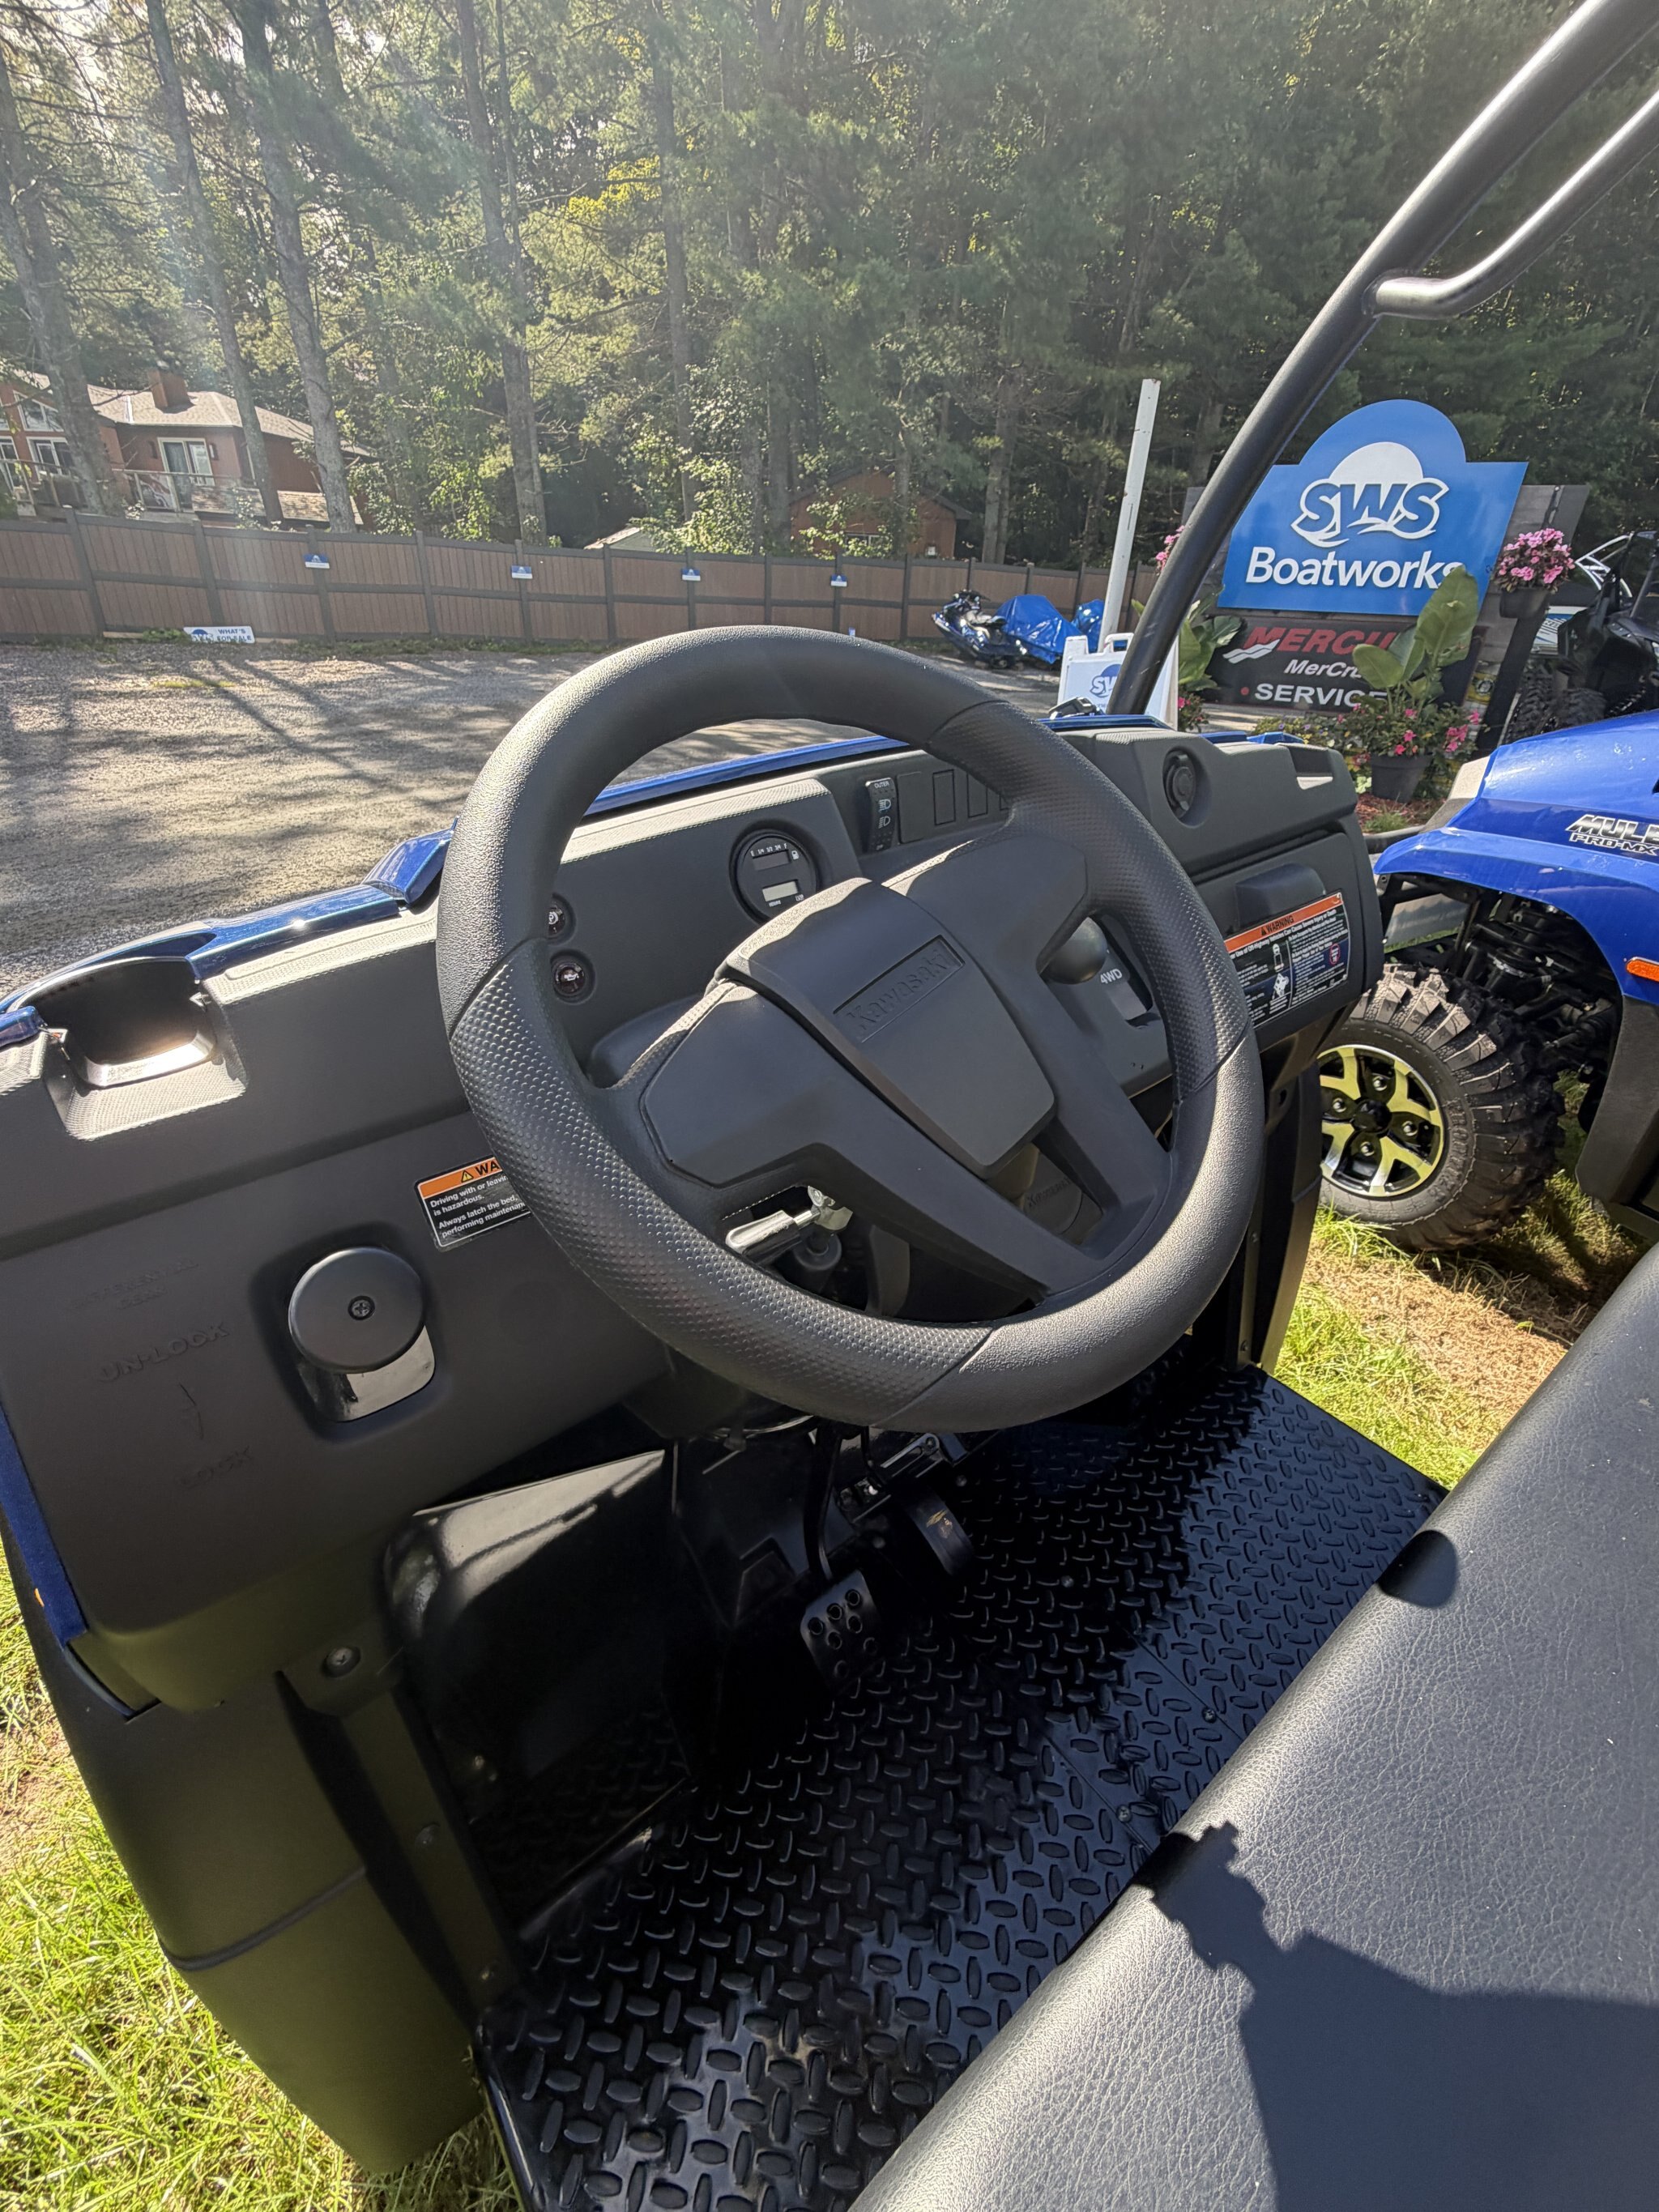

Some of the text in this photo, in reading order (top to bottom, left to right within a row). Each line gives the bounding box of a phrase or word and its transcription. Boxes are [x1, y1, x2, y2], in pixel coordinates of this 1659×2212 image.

[1290, 478, 1449, 547] SWS
[1243, 627, 1397, 655] MERCU
[1267, 915, 1294, 933] WARNING
[1100, 968, 1123, 984] 4WD
[430, 1192, 458, 1208] Driving
[459, 1187, 476, 1196] with
[486, 1175, 508, 1187] leavi
[442, 1195, 484, 1213] hazardous.
[438, 1214, 467, 1229] Always
[467, 1206, 486, 1217] latch
[487, 1202, 499, 1210] the
[442, 1203, 525, 1238] performing maintenan
